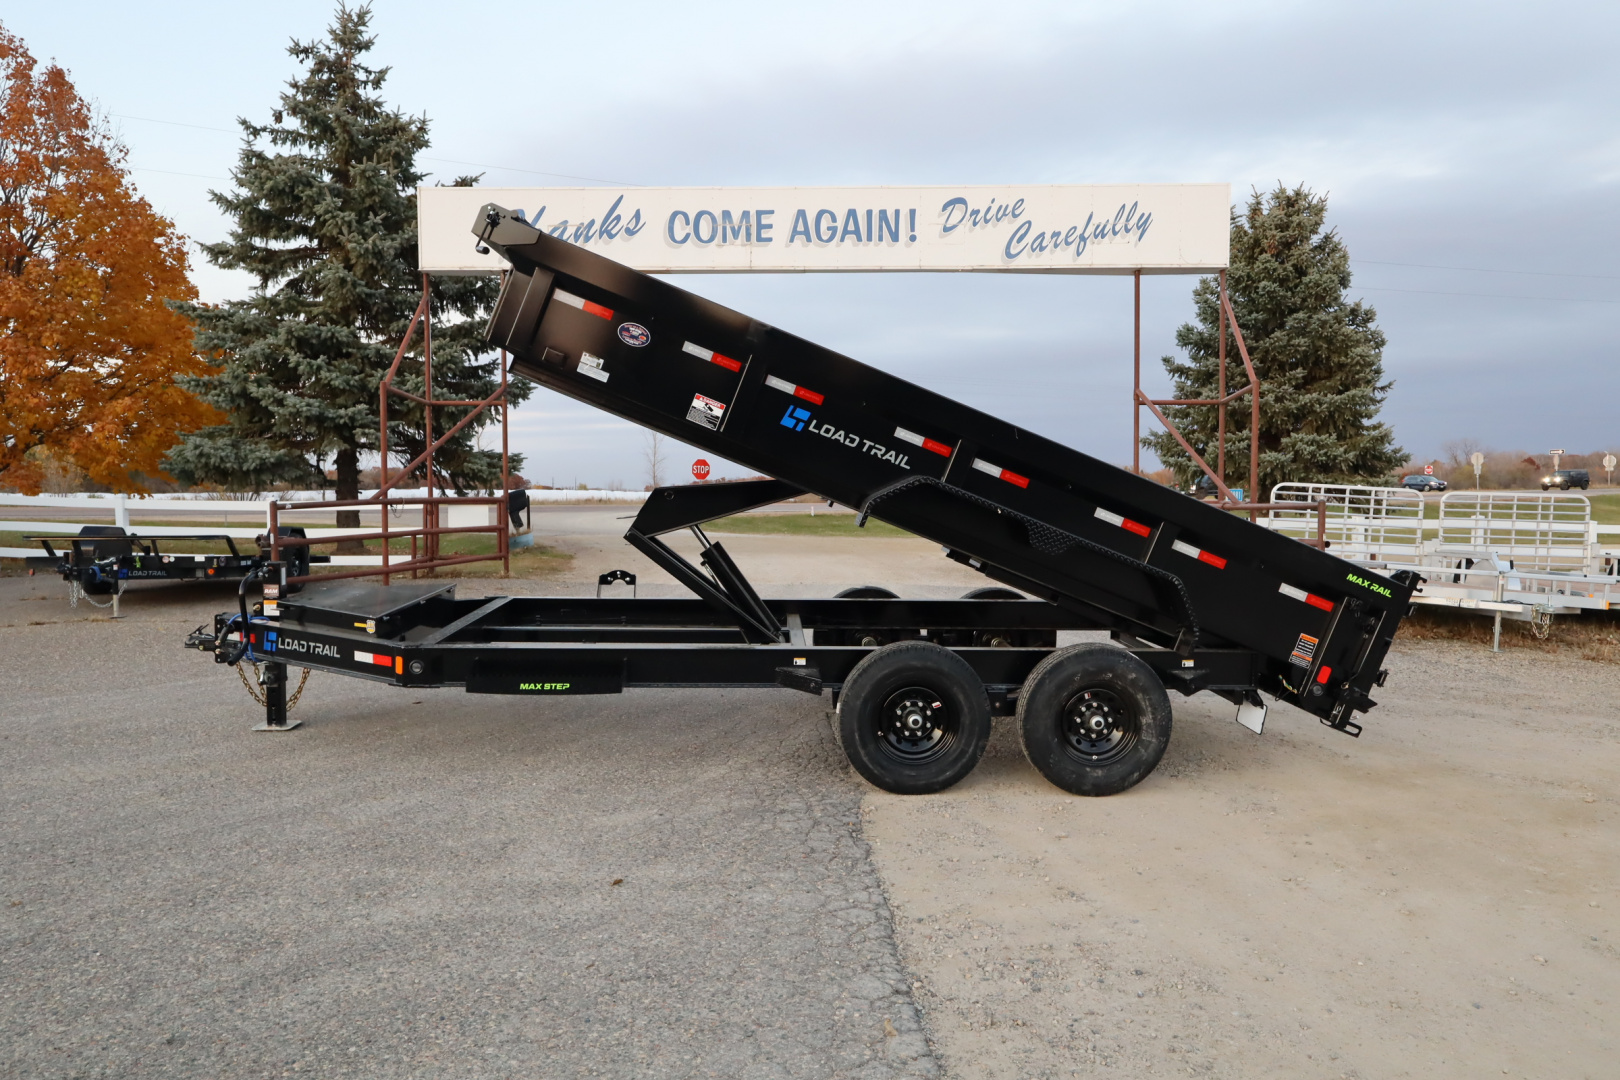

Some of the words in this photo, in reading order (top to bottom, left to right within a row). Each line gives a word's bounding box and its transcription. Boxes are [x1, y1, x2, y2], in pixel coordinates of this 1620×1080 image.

[516, 194, 647, 244] anks
[667, 209, 775, 244] COME
[789, 208, 917, 243] AGAIN!
[941, 197, 1025, 233] Drive
[1004, 201, 1153, 259] Carefully
[808, 419, 860, 448] LOAD
[862, 439, 911, 469] TRAIL
[692, 465, 709, 474] STOP
[1346, 573, 1371, 588] MAX
[1370, 583, 1392, 598] RAIL
[278, 637, 307, 652] LOAD
[308, 642, 340, 658] TRAIL
